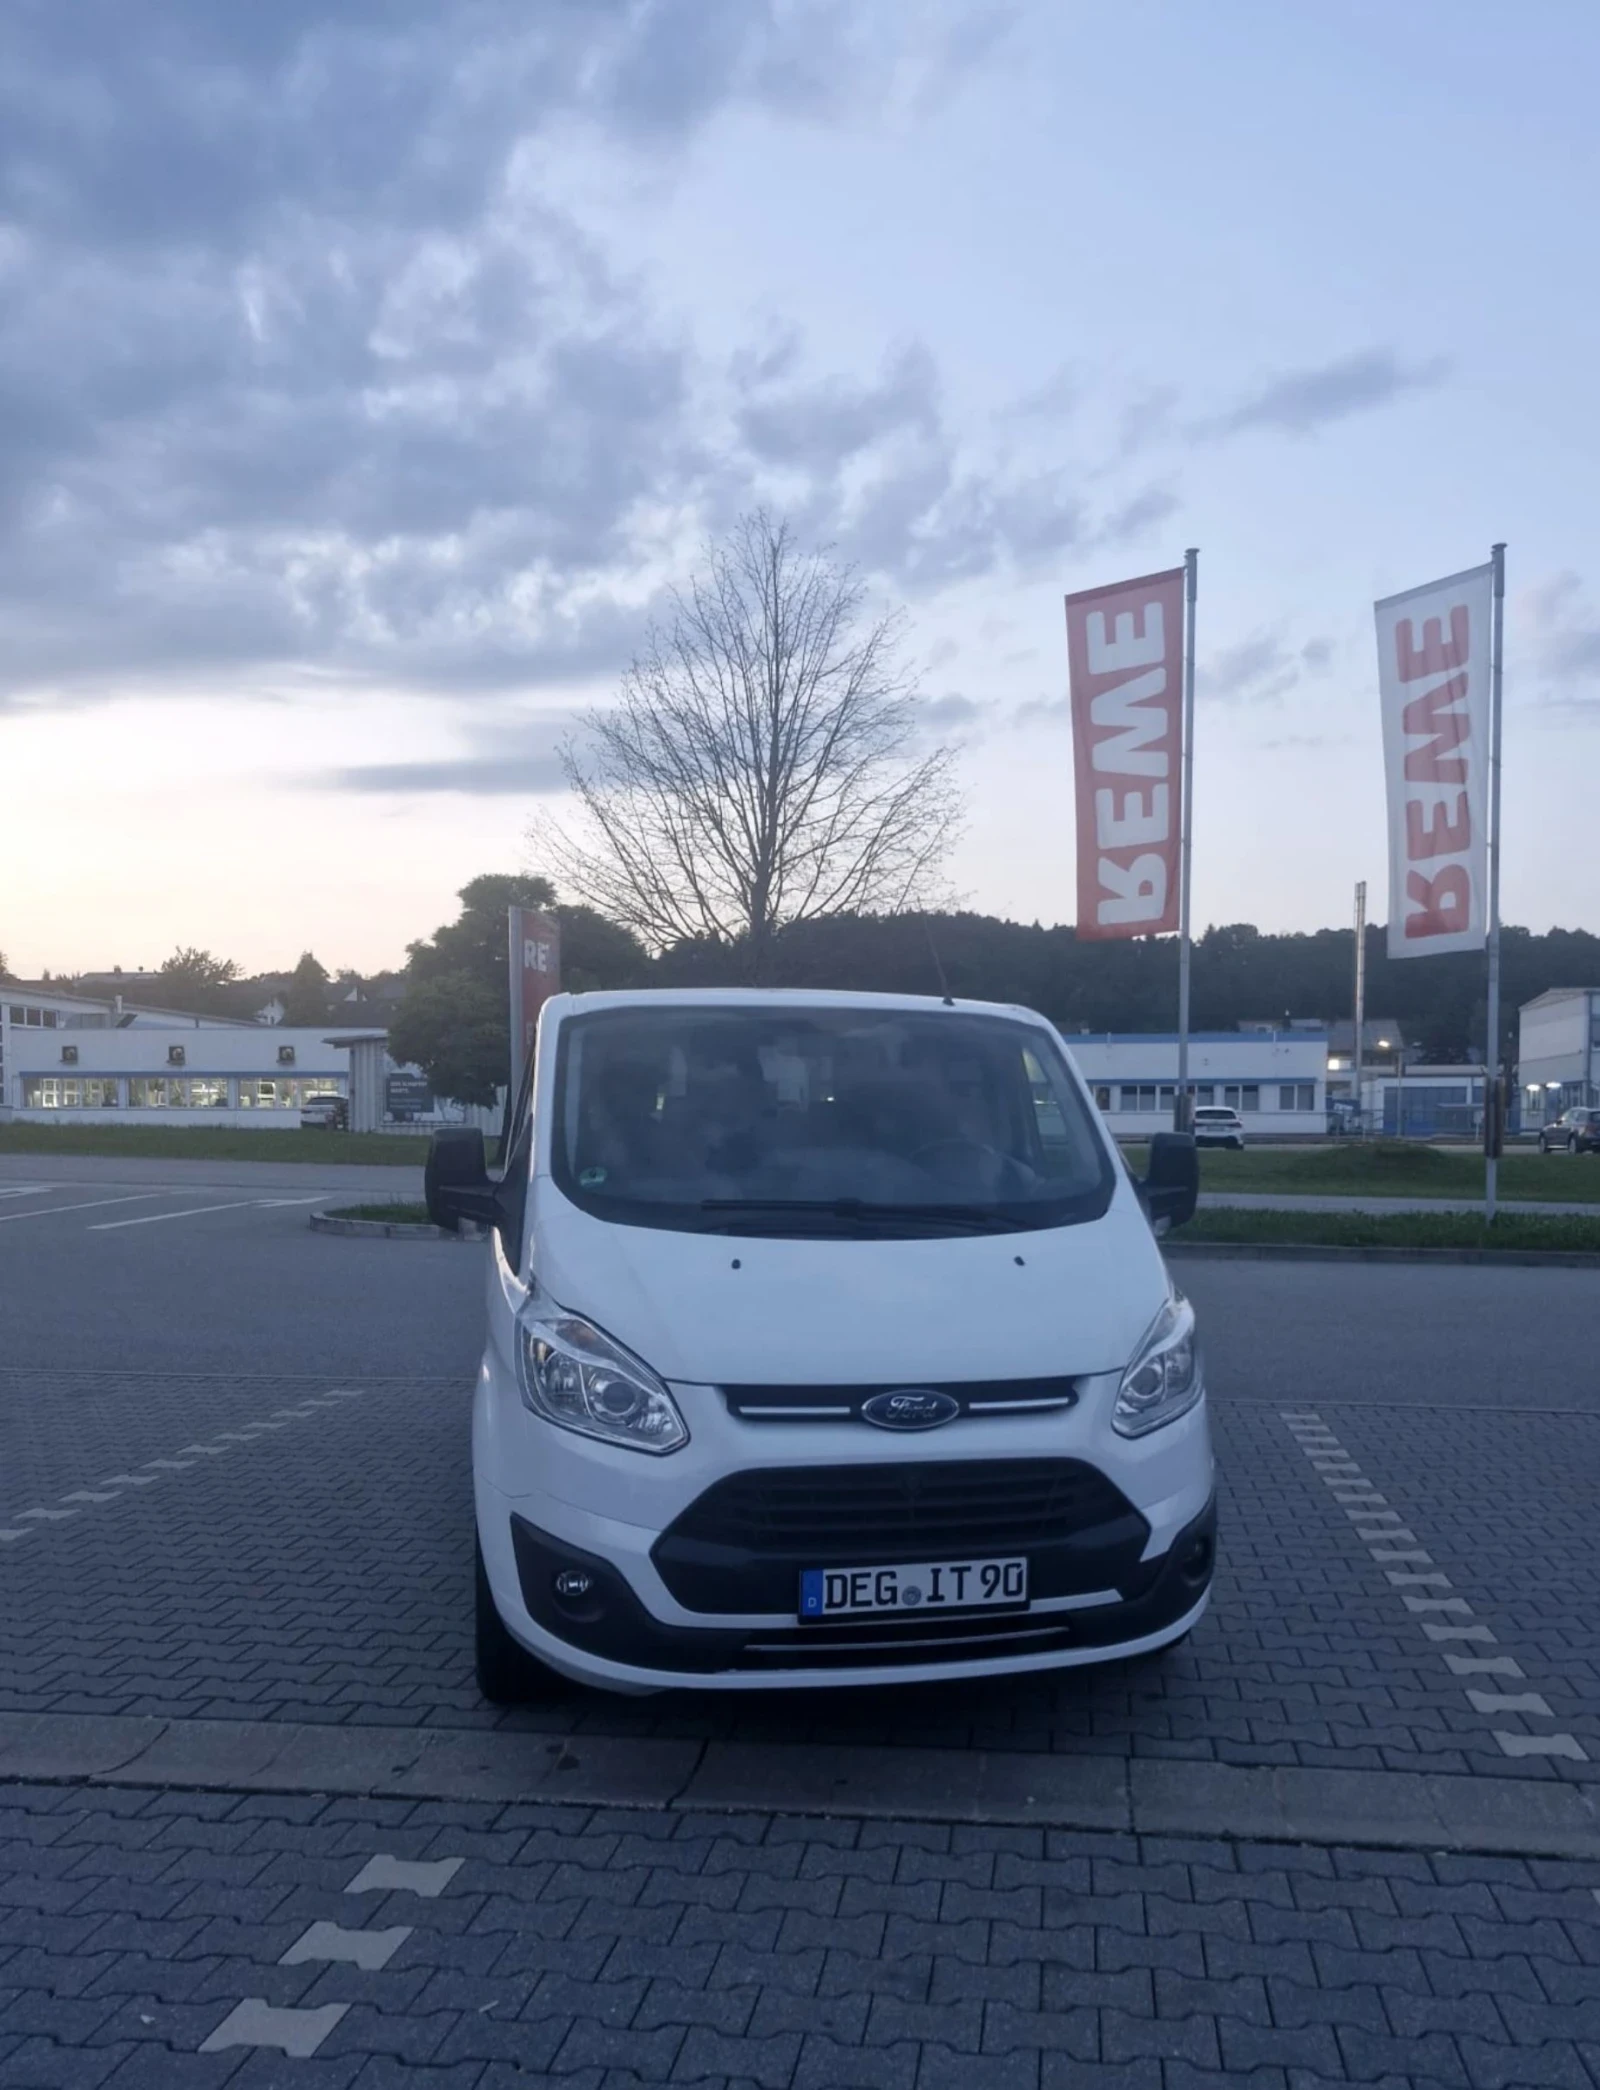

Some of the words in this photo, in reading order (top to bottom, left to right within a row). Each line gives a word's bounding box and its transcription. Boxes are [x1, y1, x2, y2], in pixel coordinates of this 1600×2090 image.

[524, 939, 551, 972] RE
[886, 1395, 938, 1419] Ford
[825, 1571, 898, 1609] DEG
[926, 1565, 972, 1603] IT
[980, 1562, 1024, 1599] 90
[808, 1597, 817, 1608] D
